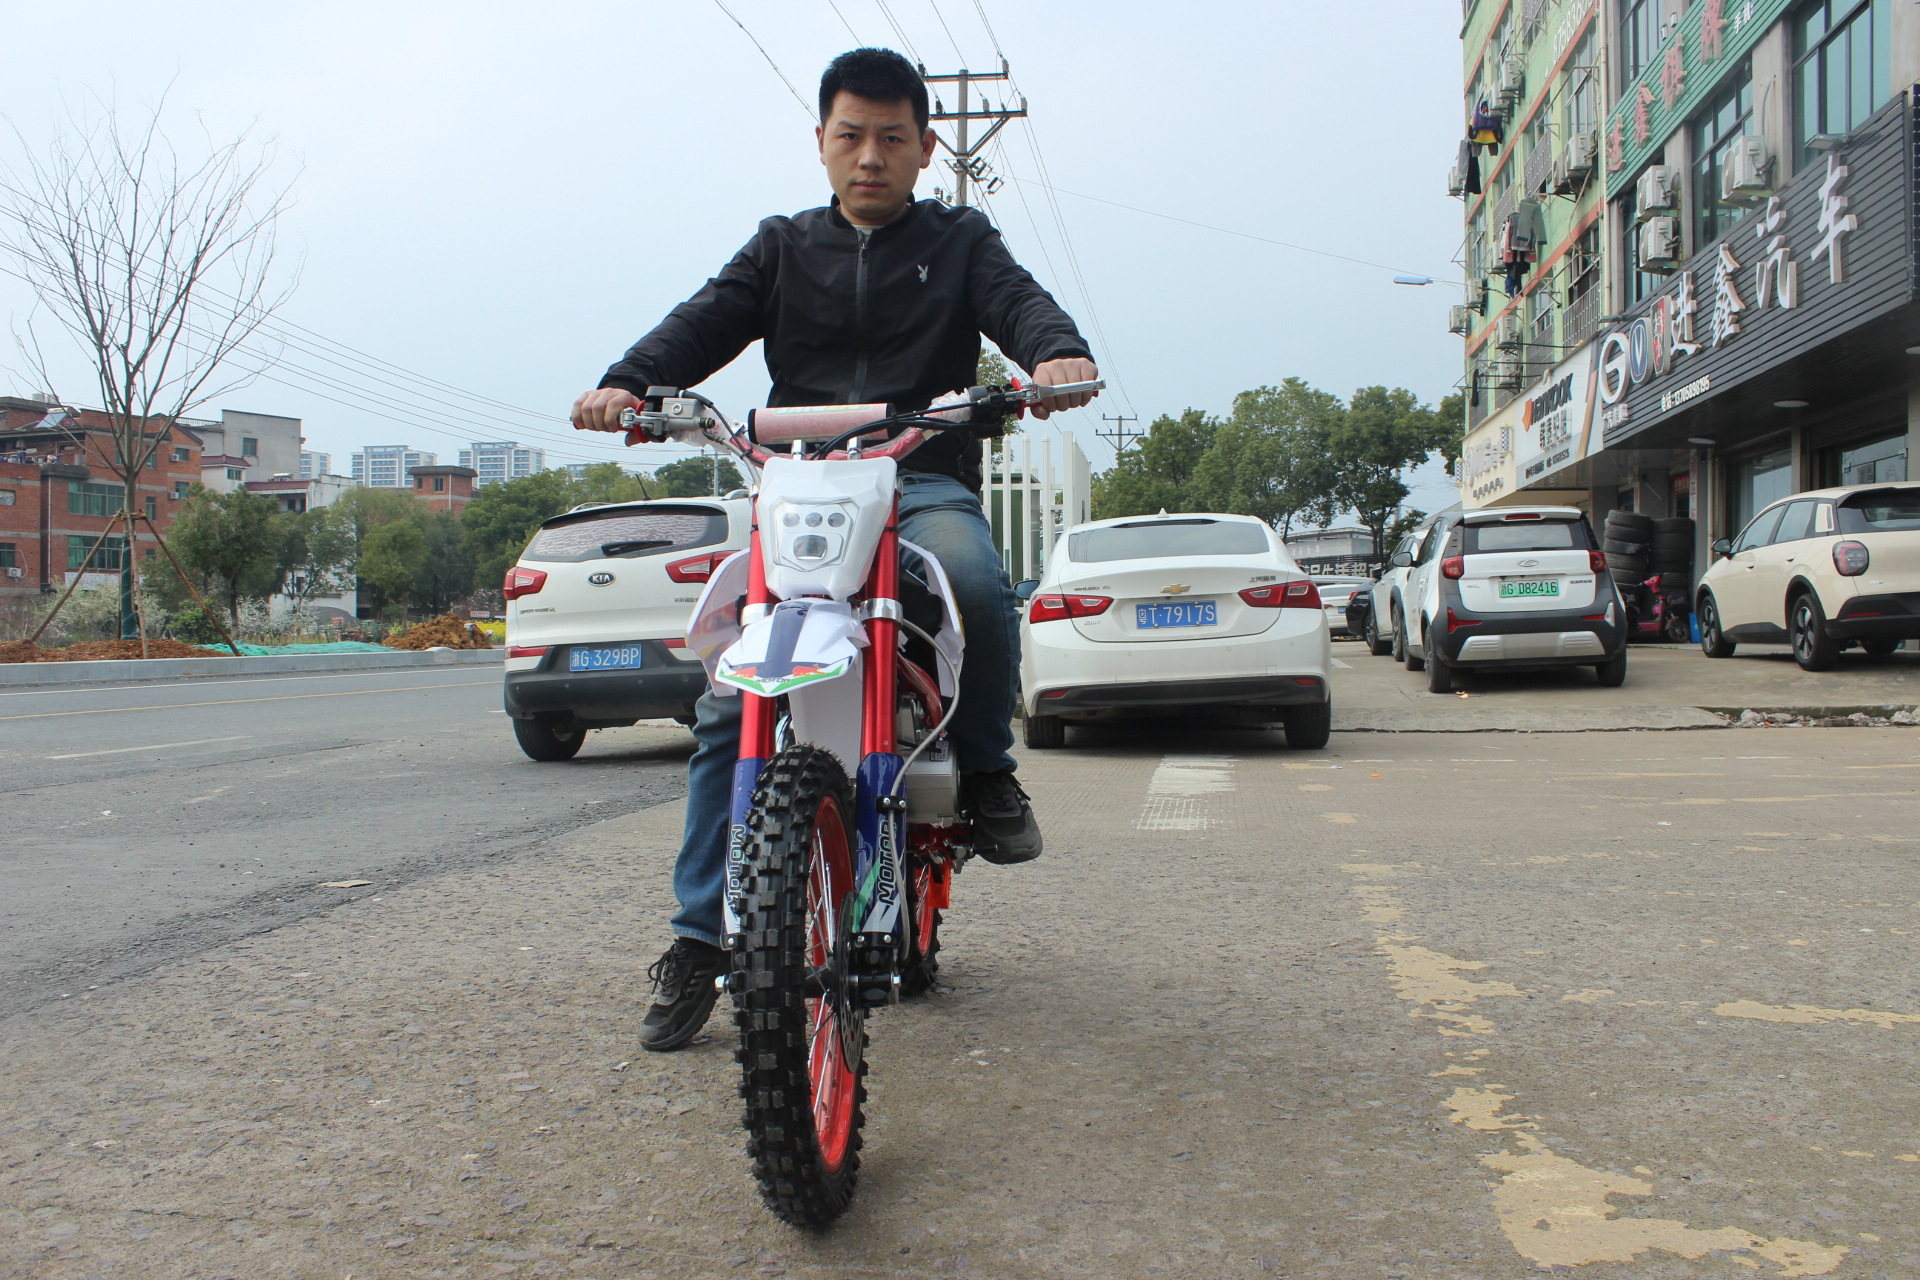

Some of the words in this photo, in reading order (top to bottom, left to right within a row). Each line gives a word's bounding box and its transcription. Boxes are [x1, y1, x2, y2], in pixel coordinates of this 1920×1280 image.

[1670, 153, 1857, 356] 进鑫汽车
[592, 574, 611, 583] KIA
[754, 677, 791, 685] MOTOR
